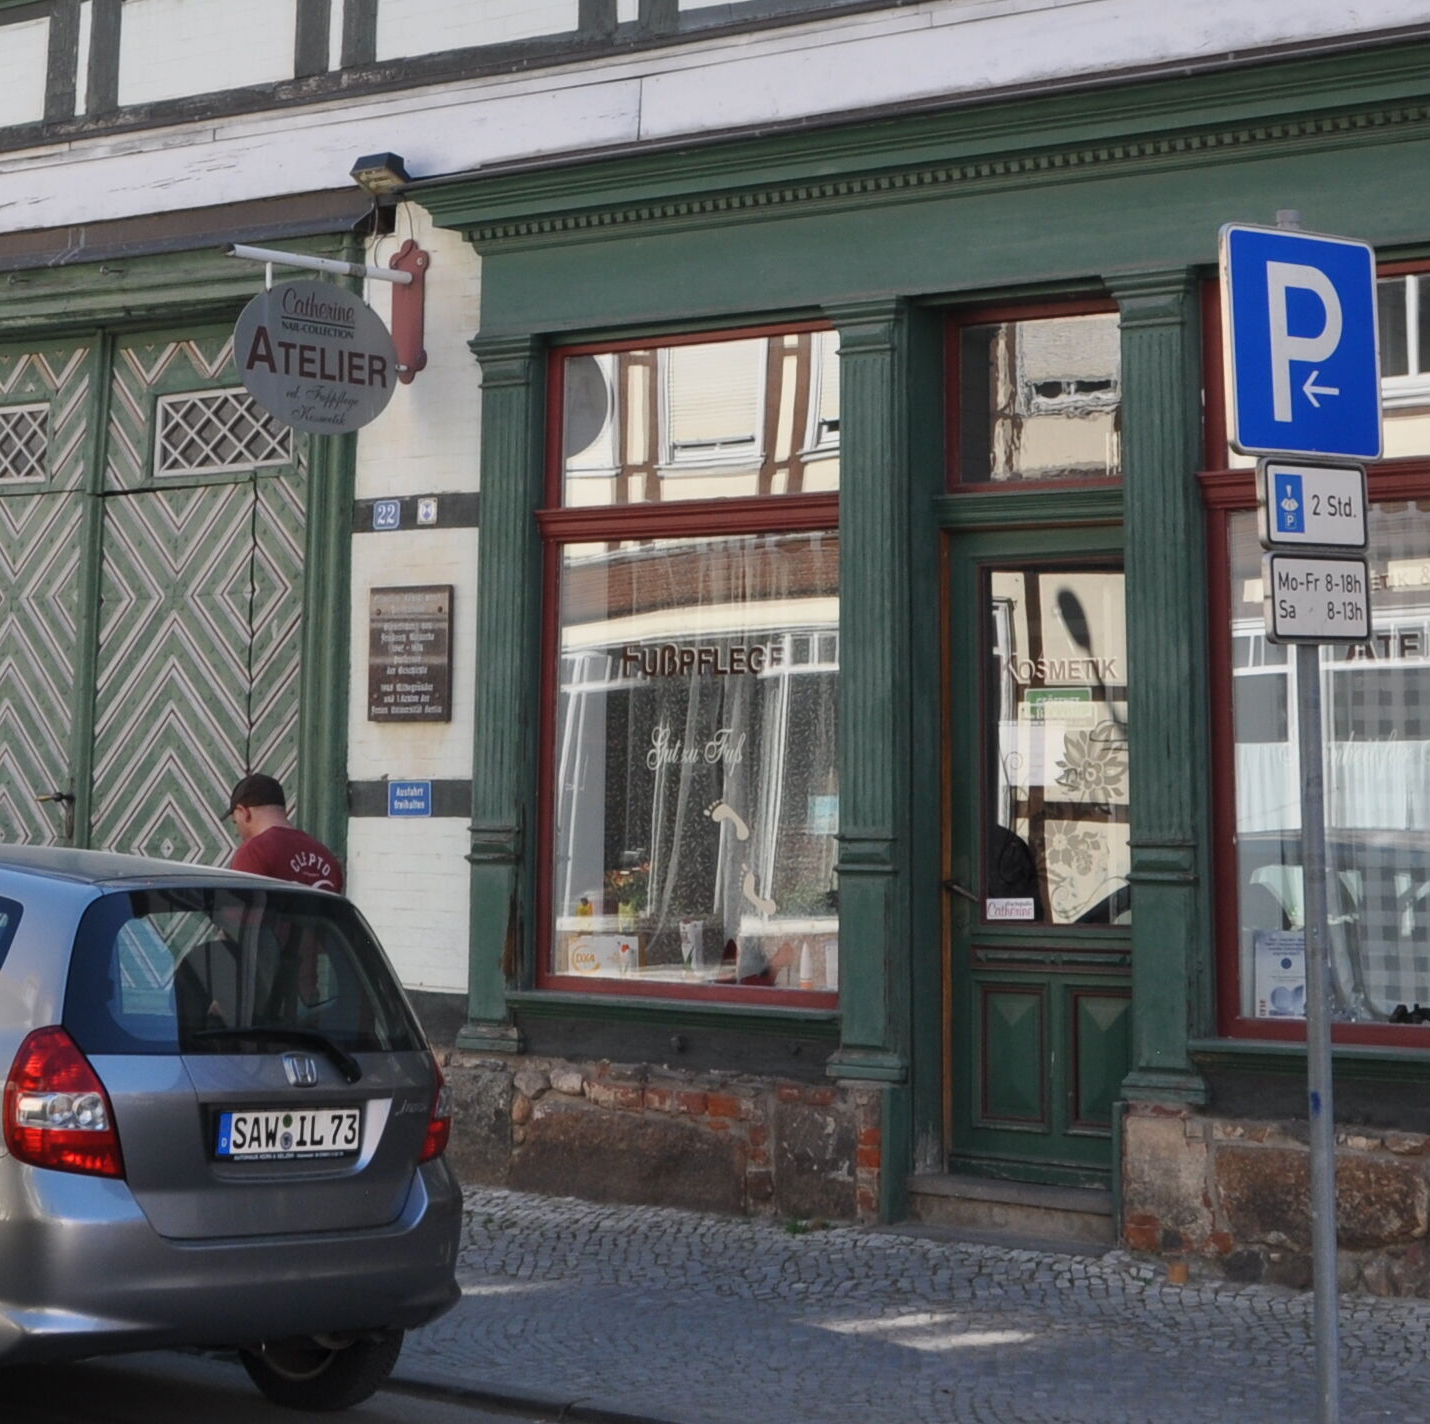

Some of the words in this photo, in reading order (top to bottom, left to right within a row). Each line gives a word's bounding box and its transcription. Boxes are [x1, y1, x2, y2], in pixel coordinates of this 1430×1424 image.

[282, 287, 356, 323] Catherine
[281, 321, 355, 339] NAIL-COLLECTION
[1266, 260, 1343, 423] P
[245, 325, 388, 388] ATELIER
[377, 503, 396, 525] 22
[1311, 494, 1321, 516] 2
[1327, 495, 1357, 518] Std.
[1278, 571, 1320, 592] Mo-Fr
[1325, 573, 1362, 593] 8-18h
[1279, 599, 1297, 619] Sa
[1327, 601, 1363, 621] 8-13h
[1001, 653, 1120, 682] KOSMETIK
[290, 851, 331, 876] CLEPTO
[232, 1116, 279, 1149] SAW
[296, 1115, 324, 1147] IL
[331, 1113, 357, 1146] 73
